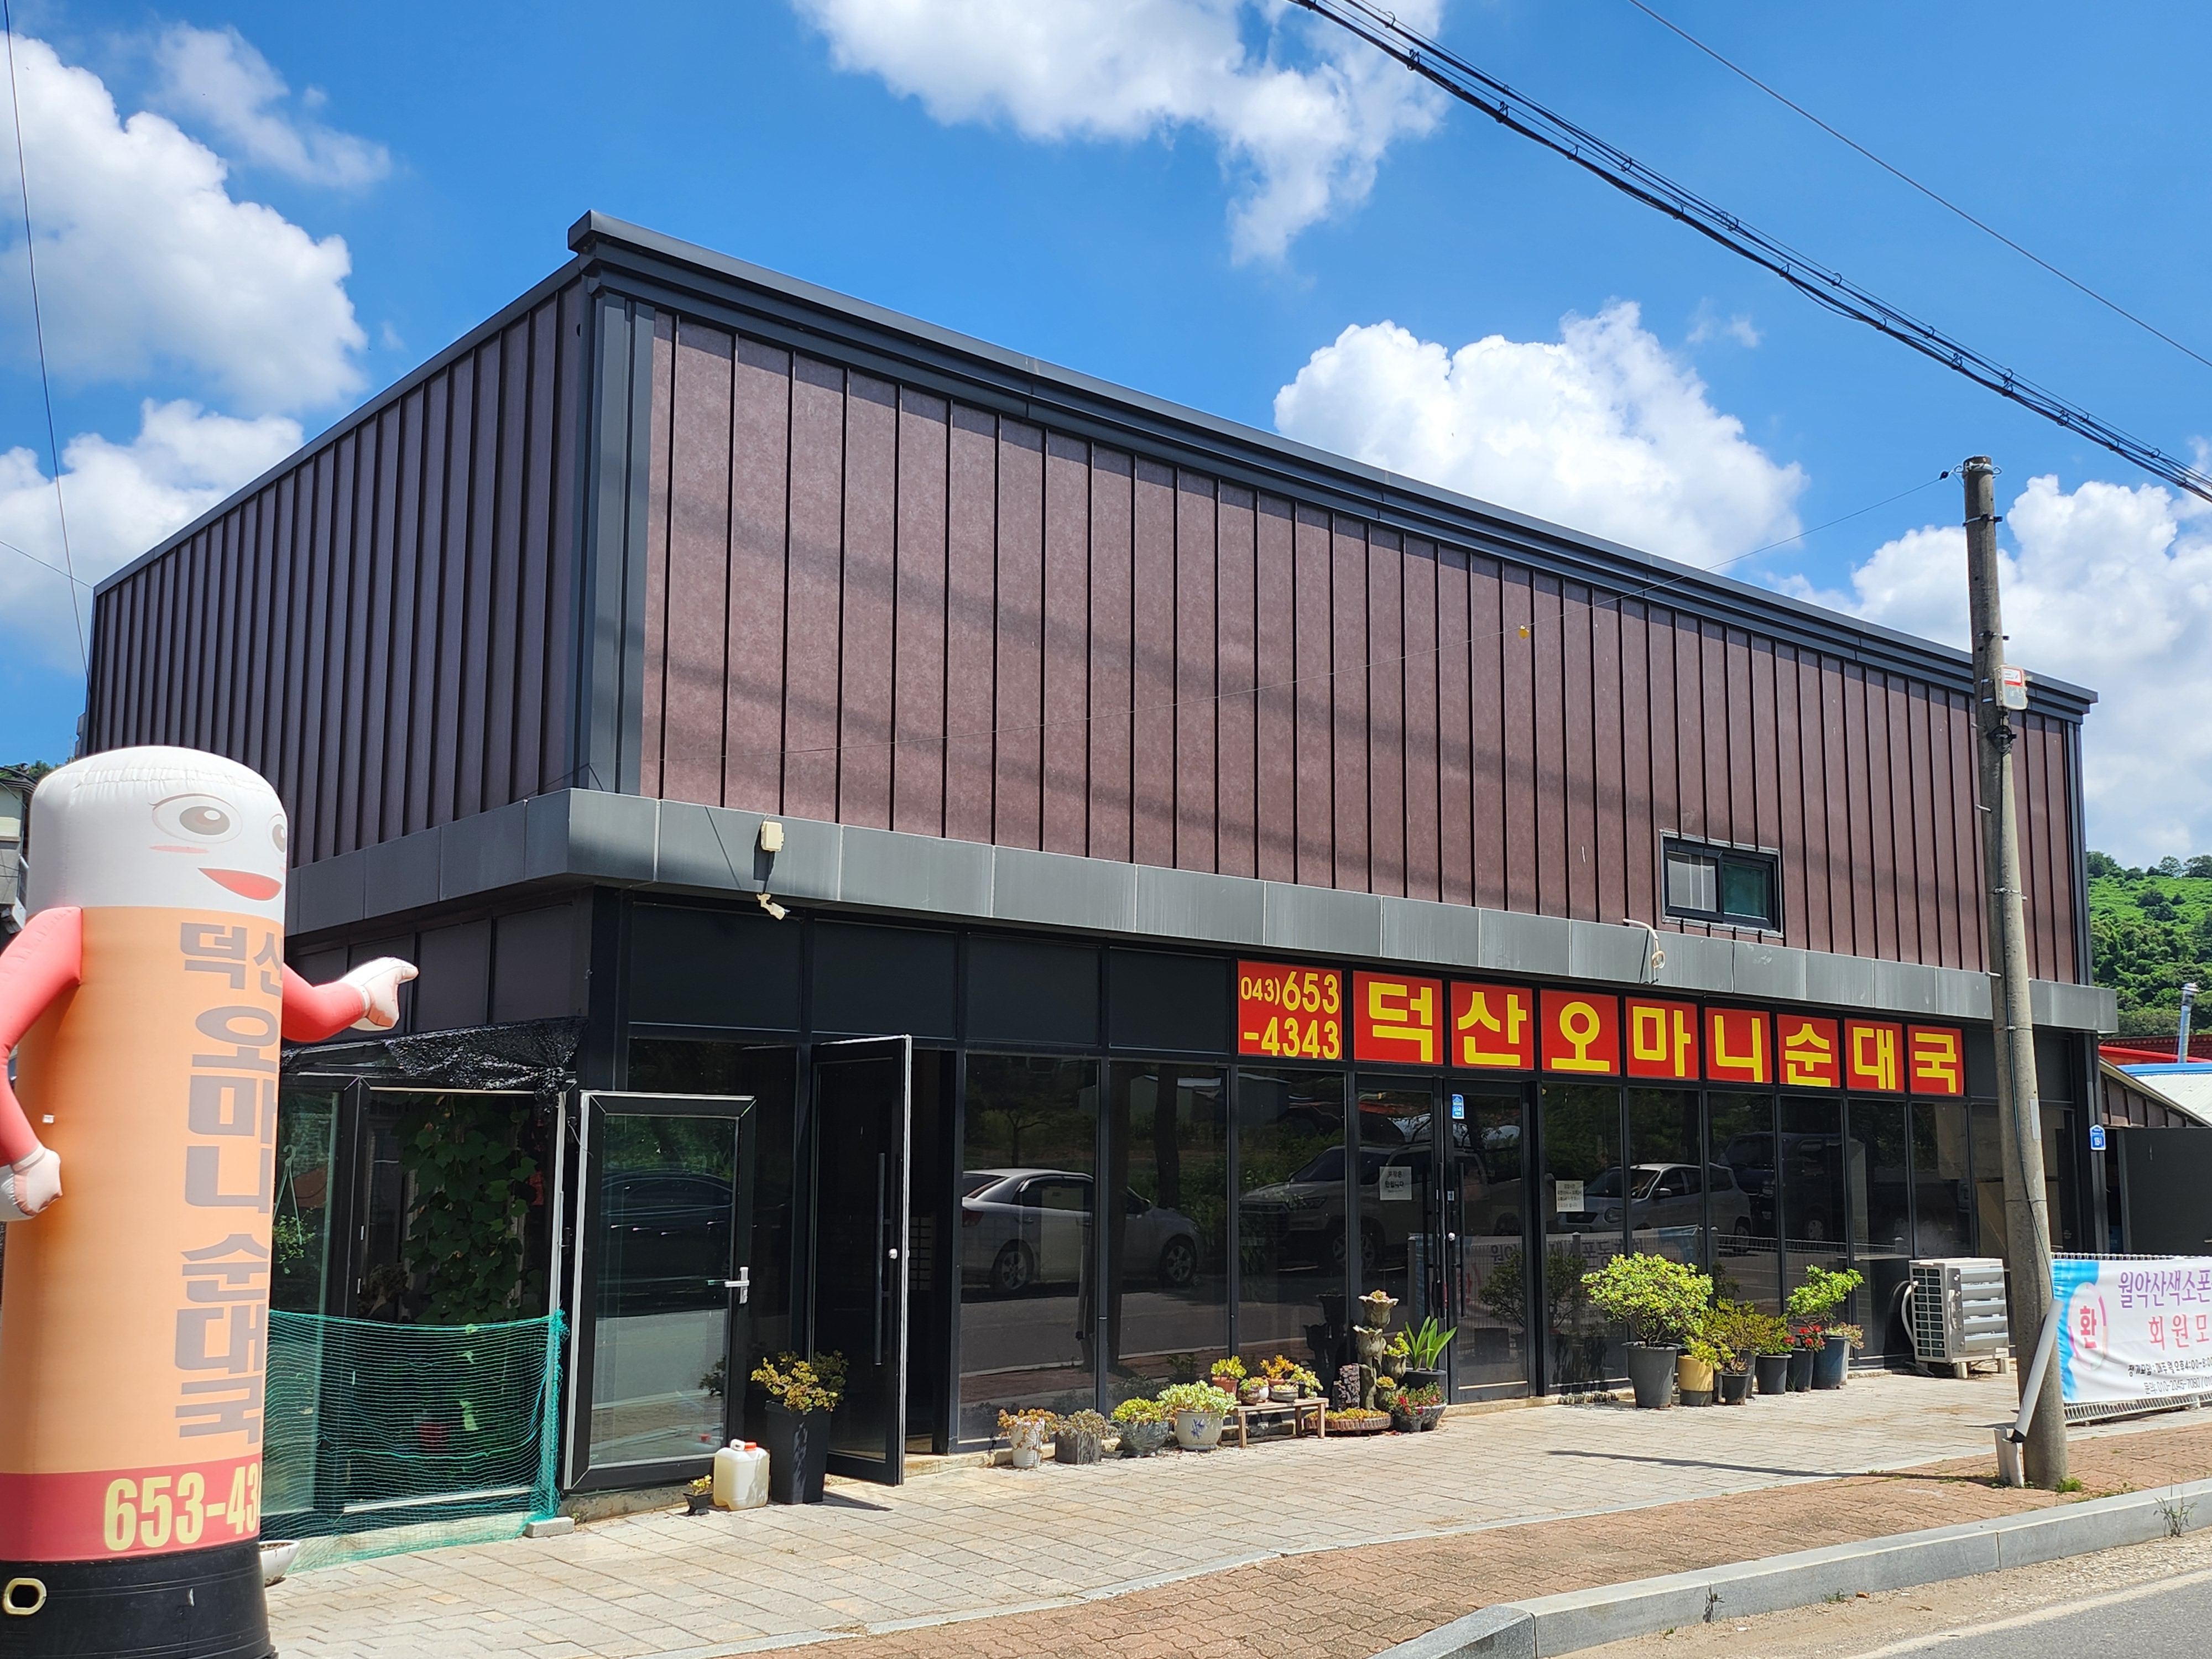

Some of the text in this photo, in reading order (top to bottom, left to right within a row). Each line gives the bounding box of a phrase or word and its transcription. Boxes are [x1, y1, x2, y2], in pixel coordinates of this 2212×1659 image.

[2118, 1269, 2212, 1308] 월악산색소폰
[2080, 1306, 2097, 1349] 환
[104, 1462, 262, 1551] 653-43
